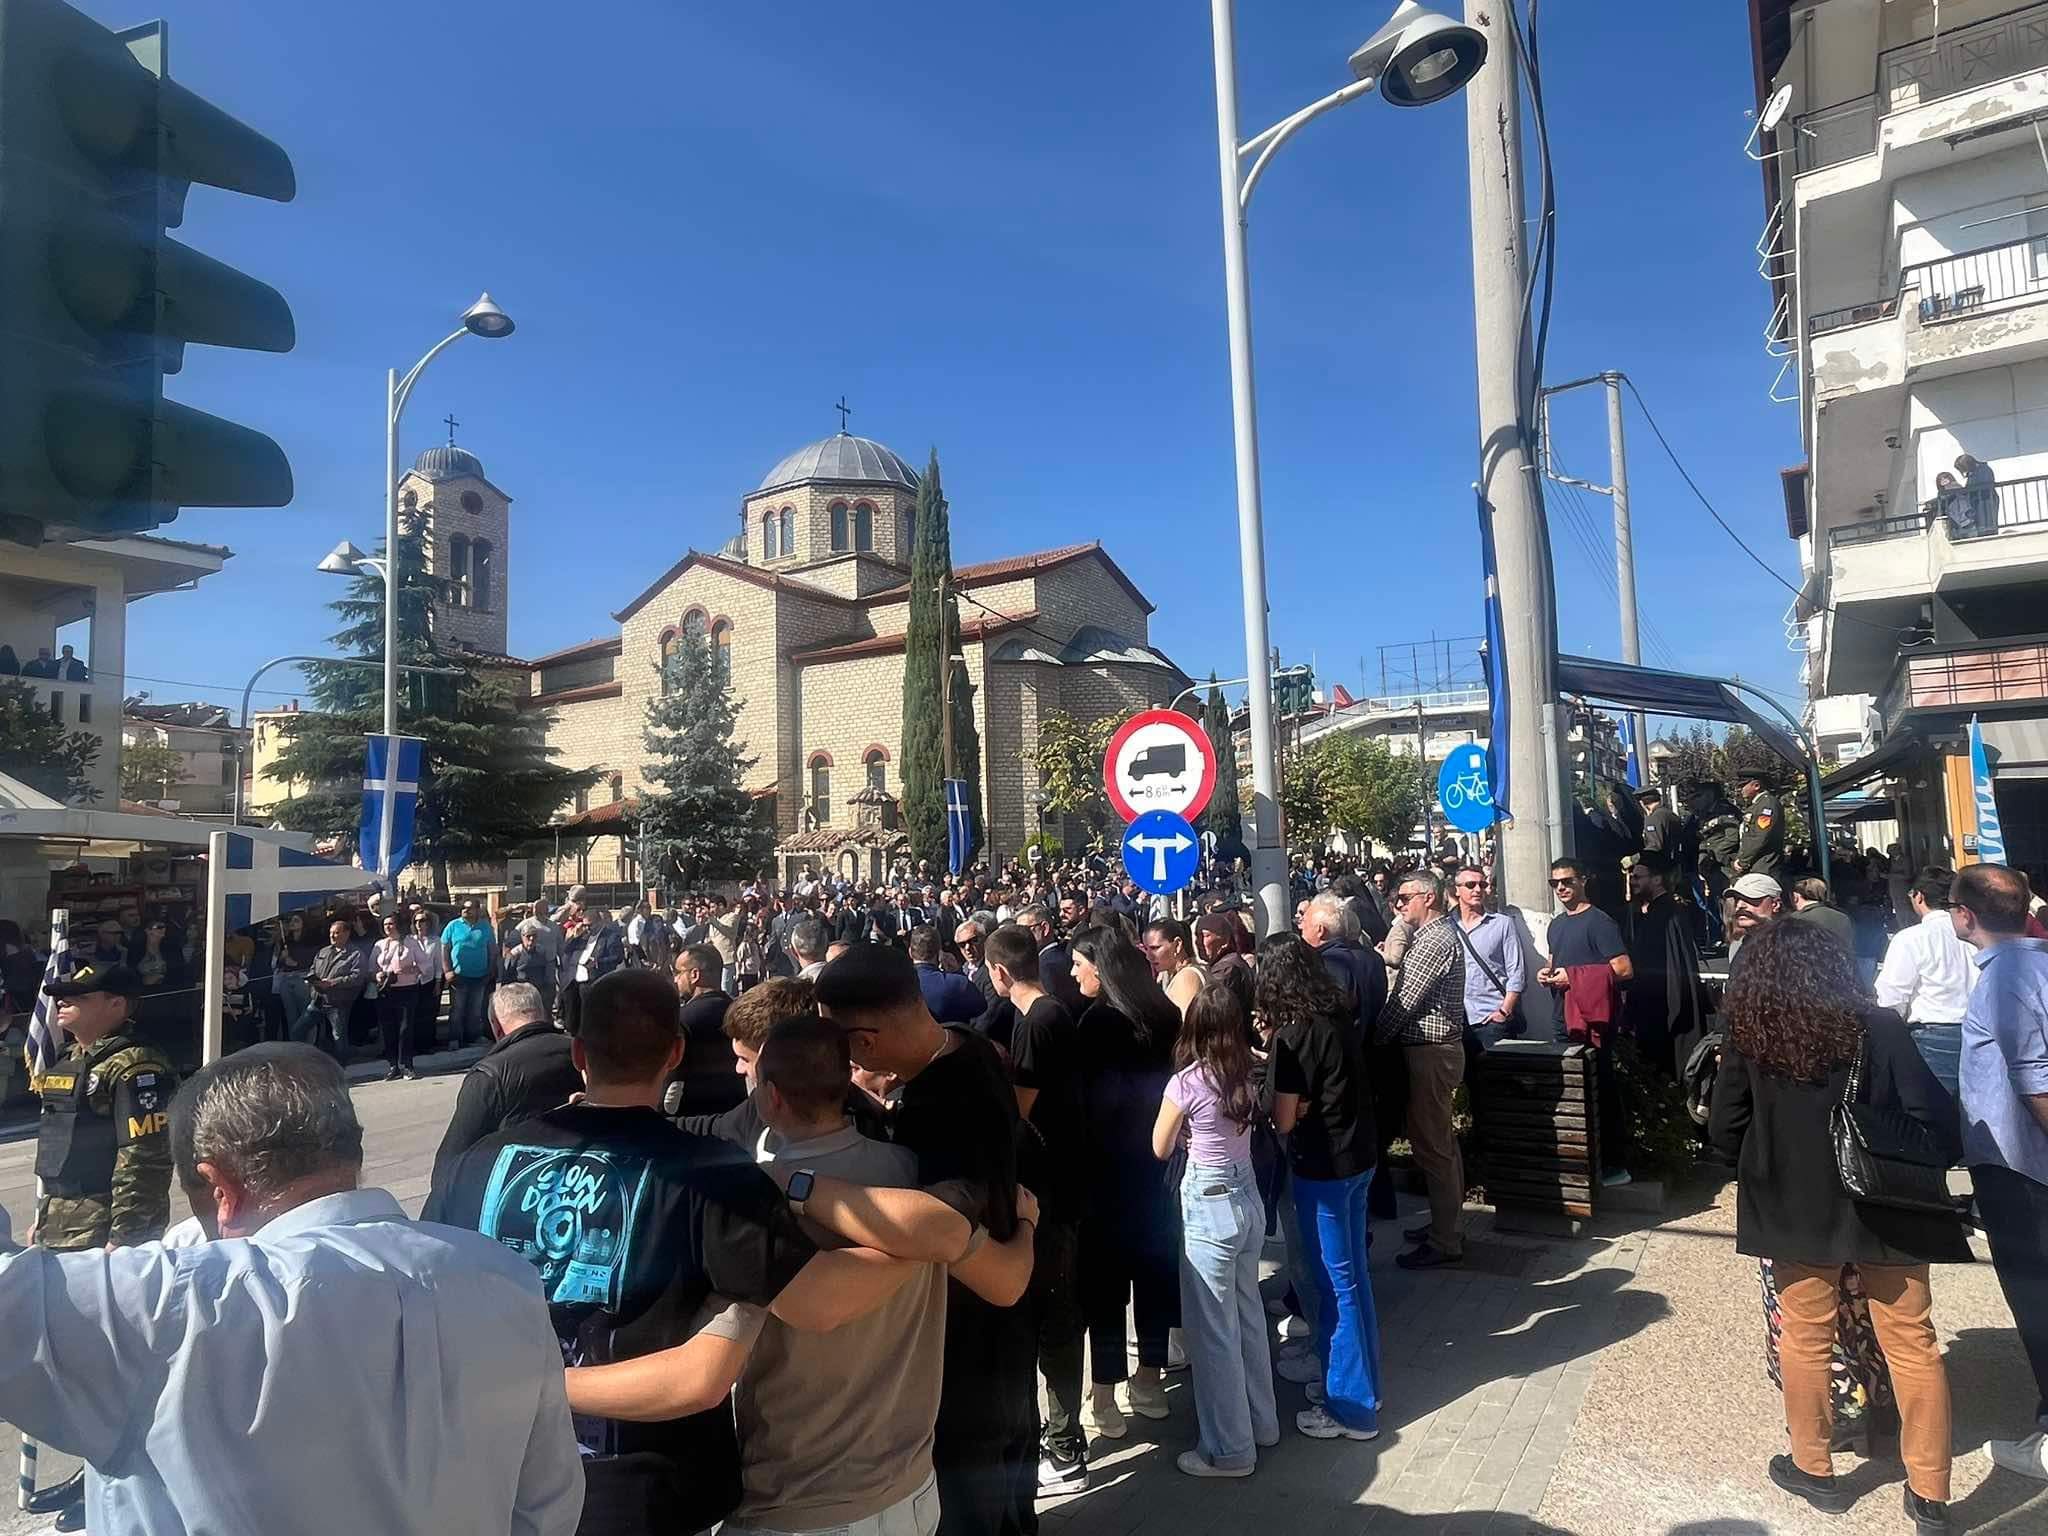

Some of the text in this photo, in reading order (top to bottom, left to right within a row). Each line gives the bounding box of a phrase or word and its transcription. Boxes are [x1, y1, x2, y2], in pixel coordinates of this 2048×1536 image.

[128, 1112, 168, 1138] MP
[537, 1163, 605, 1193] SLOW
[521, 1186, 607, 1216] DOWN
